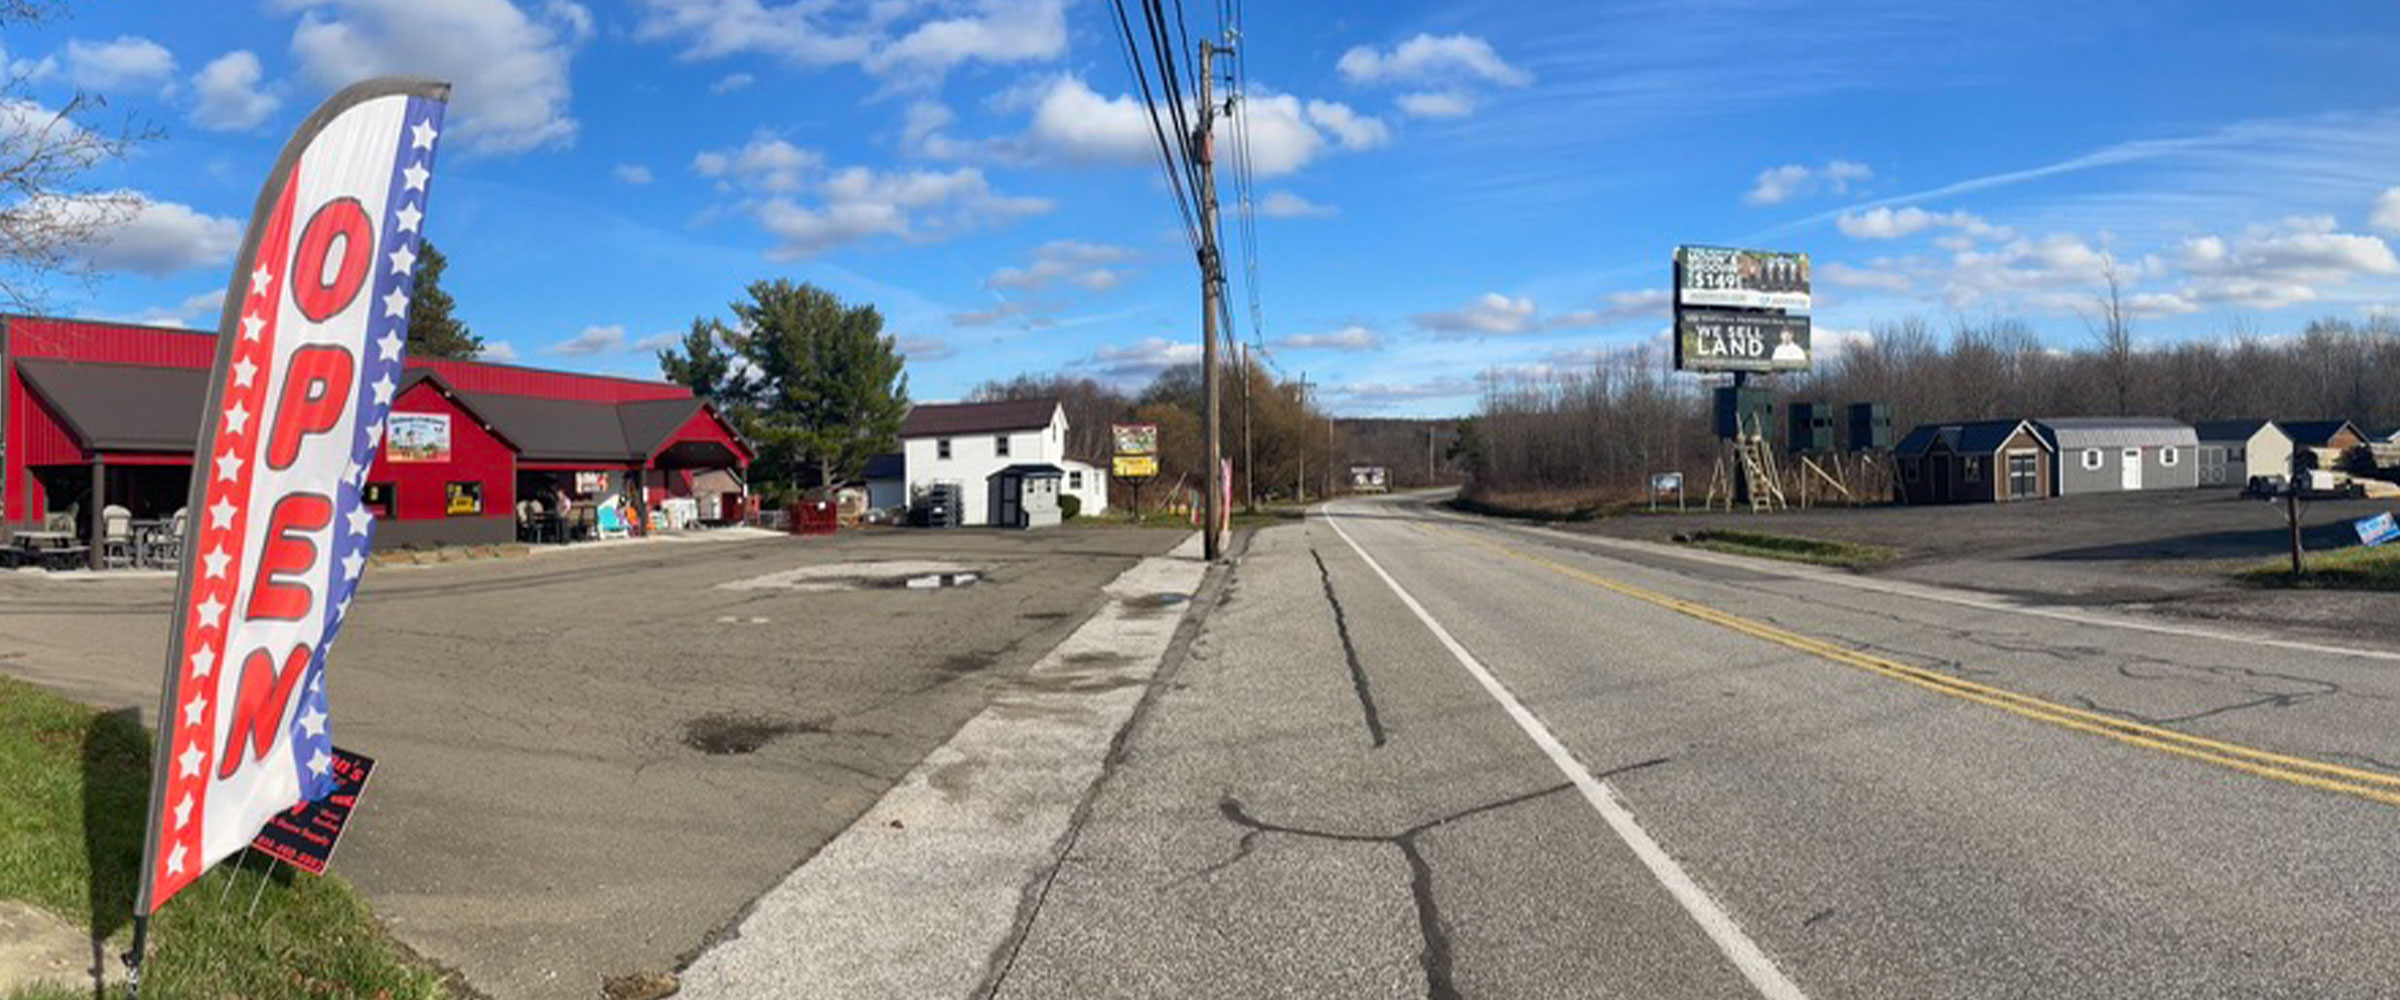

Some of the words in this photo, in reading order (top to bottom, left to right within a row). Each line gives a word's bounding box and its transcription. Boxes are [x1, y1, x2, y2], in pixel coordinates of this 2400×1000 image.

[1695, 271, 1736, 289] $149
[1696, 324, 1721, 338] WE
[1727, 325, 1764, 339] SELL
[1697, 337, 1764, 357] LAND
[216, 196, 375, 780] OPEN
